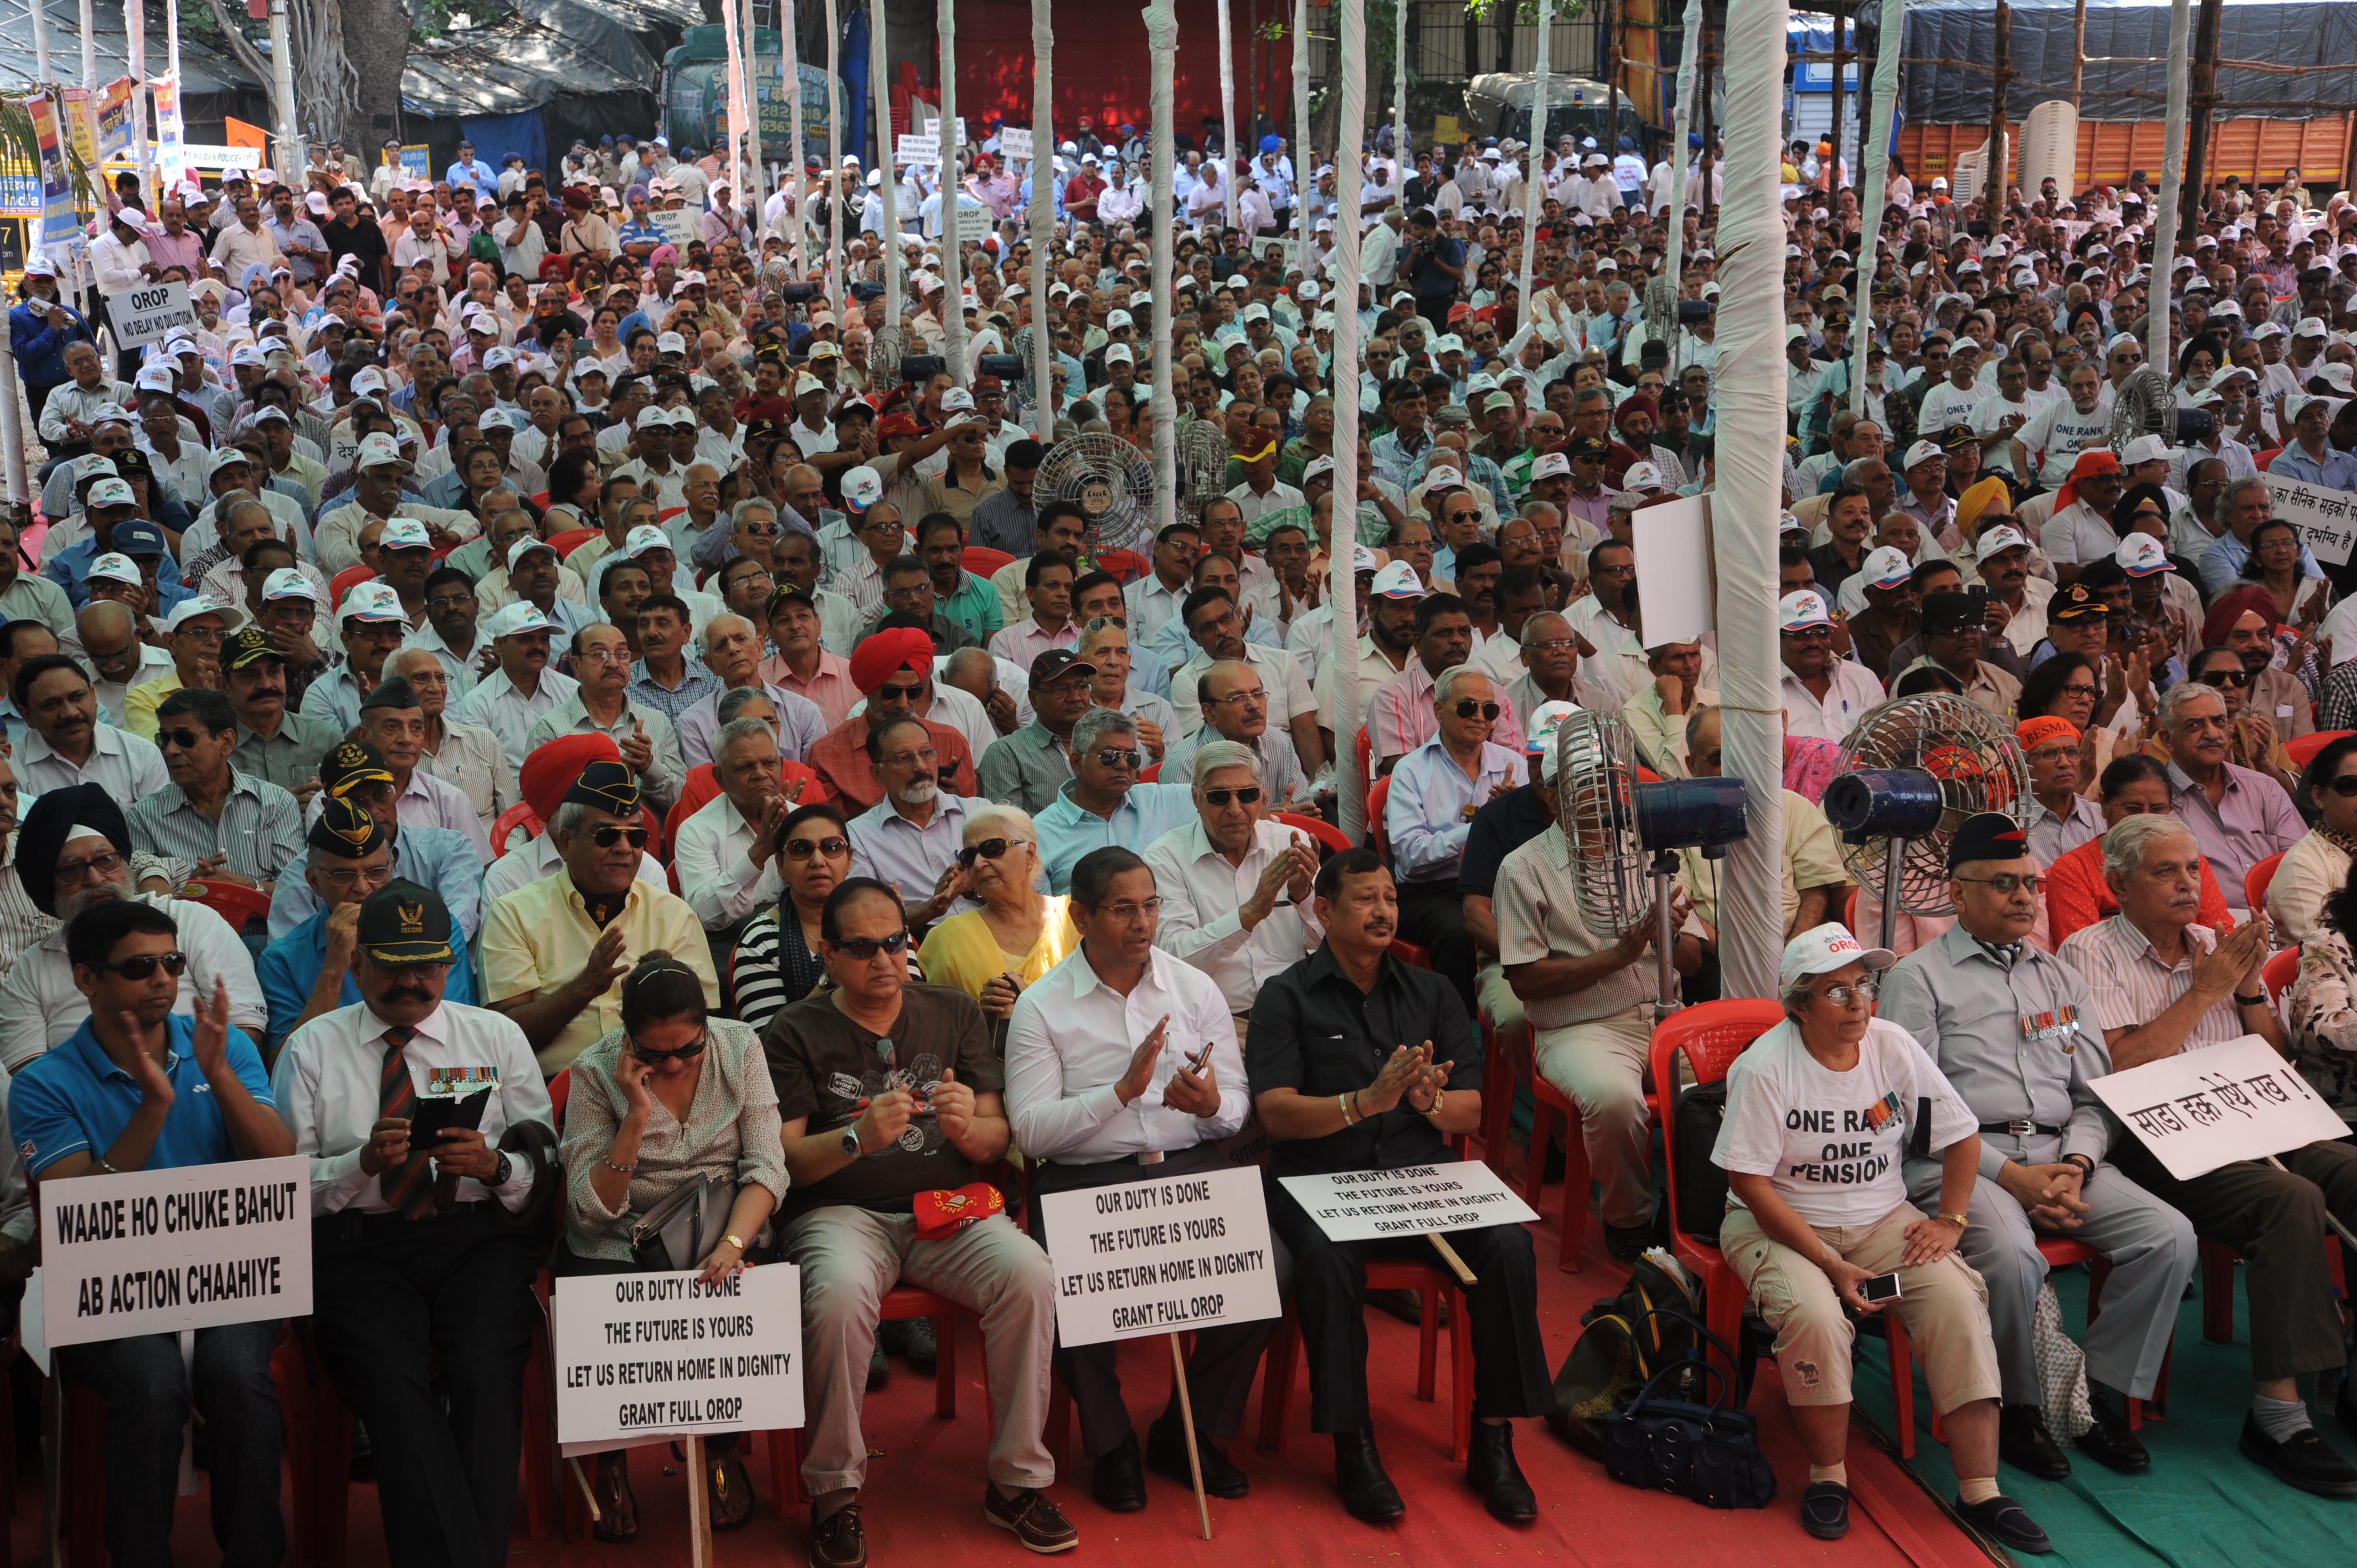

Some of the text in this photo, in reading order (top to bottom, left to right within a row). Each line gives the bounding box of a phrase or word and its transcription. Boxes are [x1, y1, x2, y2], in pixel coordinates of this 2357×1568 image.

[217, 153, 239, 163] POLICE
[4, 193, 39, 207] India
[655, 213, 677, 221] OROP
[1, 226, 11, 245] 7
[131, 288, 168, 310] OROP
[122, 309, 194, 338] NO DELAY NO DILUTION
[1947, 405, 1965, 415] ONE
[2056, 424, 2104, 436] ONE RANK
[2276, 485, 2350, 519] का सैनिक सड़कों
[2305, 525, 2353, 551] दुर्भाग्य है
[965, 618, 972, 629] S
[2025, 722, 2072, 746] BESMA
[832, 1087, 856, 1098] AUSTRALIA
[835, 1080, 856, 1092] SYDNEY
[2126, 1102, 2190, 1139] साडा
[2242, 1074, 2292, 1106] रख
[1786, 1109, 1835, 1133] ONE
[902, 1133, 922, 1146] HOBART
[1229, 1133, 1269, 1165] FUTURE
[1821, 1142, 1872, 1162] ONE
[1332, 1167, 1439, 1185] OUR DUTY IS DONE
[1790, 1154, 1890, 1184] PENSION
[1096, 1180, 1208, 1215] OUR DUTY IS DONE
[1335, 1181, 1463, 1200] THE FUTURE IS YOURS
[57, 1182, 296, 1244] WAADE HO CHUKE BAHUT
[1316, 1192, 1508, 1219] LET US RETURN HOME IN DIGNITY
[1375, 1213, 1480, 1231] GRANT FULL OROP
[1090, 1217, 1226, 1254] THE FUTURE IS YOURS
[1062, 1250, 1263, 1297] LET US RETURN HOME IN DIGNITY
[78, 1256, 281, 1317] AB ACTION CHAAHIYE
[616, 1276, 740, 1303] OUR DUTY IS DONE
[1113, 1294, 1224, 1329] GRANT FULL OROP
[605, 1315, 753, 1344] THE FUTURE IS YOURS
[568, 1354, 790, 1388] LET US RETURN HOME IN DIGNITY
[619, 1398, 742, 1425] GRANT FULL OROP
